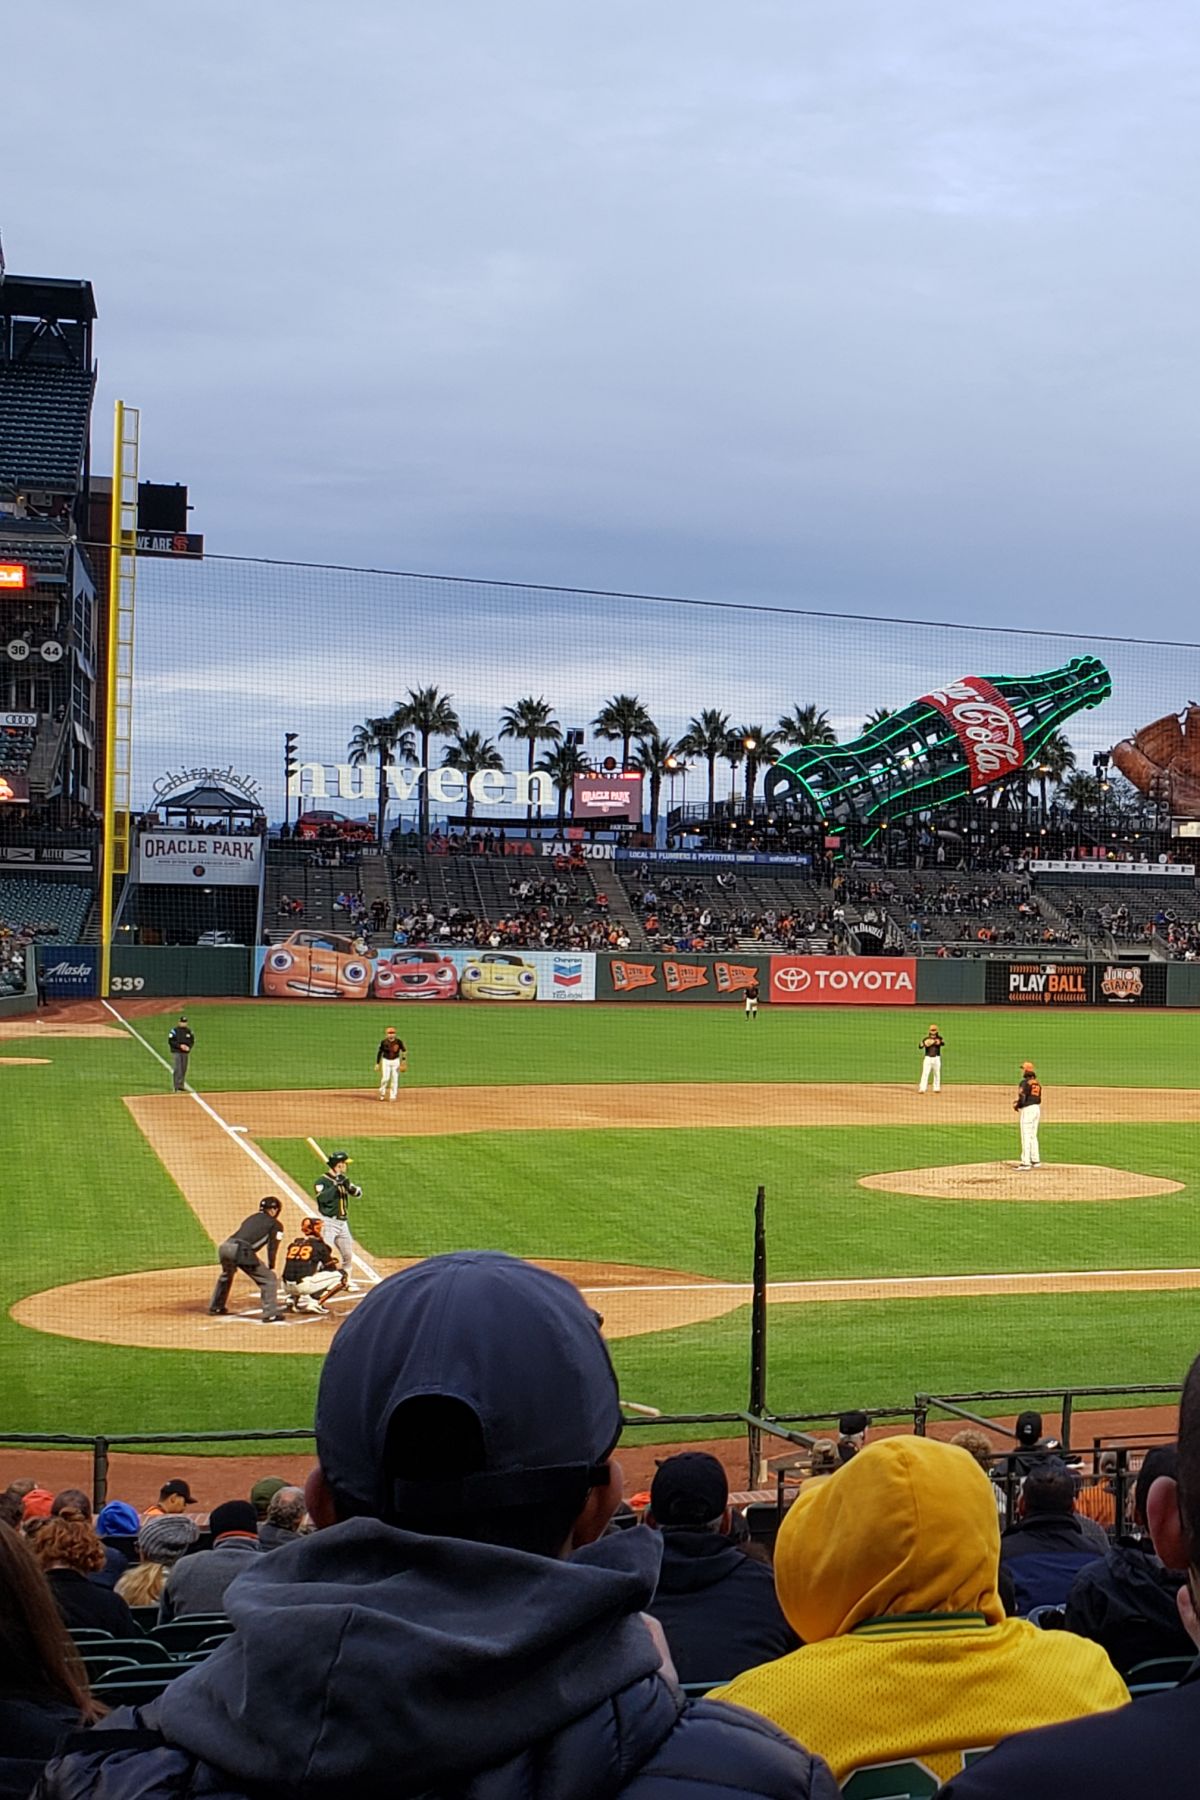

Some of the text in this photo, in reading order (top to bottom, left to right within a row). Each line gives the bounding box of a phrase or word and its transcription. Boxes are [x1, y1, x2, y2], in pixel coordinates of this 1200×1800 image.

[152, 537, 172, 551] ARE
[11, 645, 59, 656] 36 44
[153, 765, 262, 797] Ghirardelli
[284, 762, 556, 806] nuveen
[145, 838, 255, 861] ORACLE PARK
[629, 851, 649, 859] LOCAL
[658, 852, 691, 861] PLUMBERS
[47, 962, 92, 977] Alaska
[1103, 966, 1142, 983] JUNIOR
[111, 976, 145, 991] 339
[814, 970, 913, 991] TOYOTA
[1009, 973, 1086, 993] PLAY BALL
[1100, 979, 1144, 997] GIANTS
[287, 1245, 313, 1260] 28
